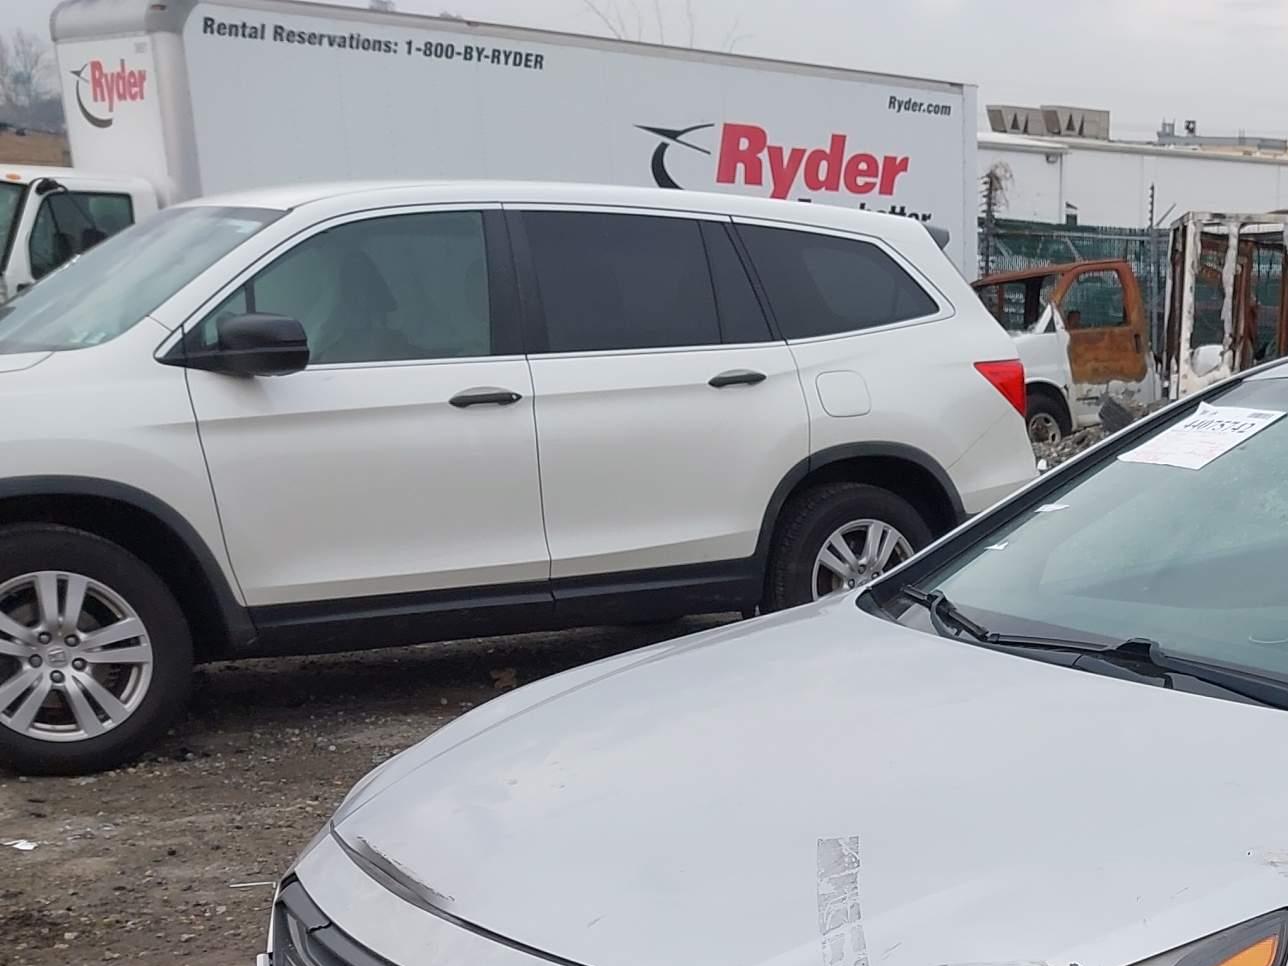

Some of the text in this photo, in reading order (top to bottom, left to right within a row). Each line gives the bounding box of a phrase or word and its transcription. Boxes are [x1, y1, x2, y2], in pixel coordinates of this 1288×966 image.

[203, 16, 544, 70] Rental Reservations: 1-800-BY-RYDER
[90, 58, 146, 113] Ryder
[888, 95, 952, 116] Ryder.com
[716, 122, 910, 200] Ryder
